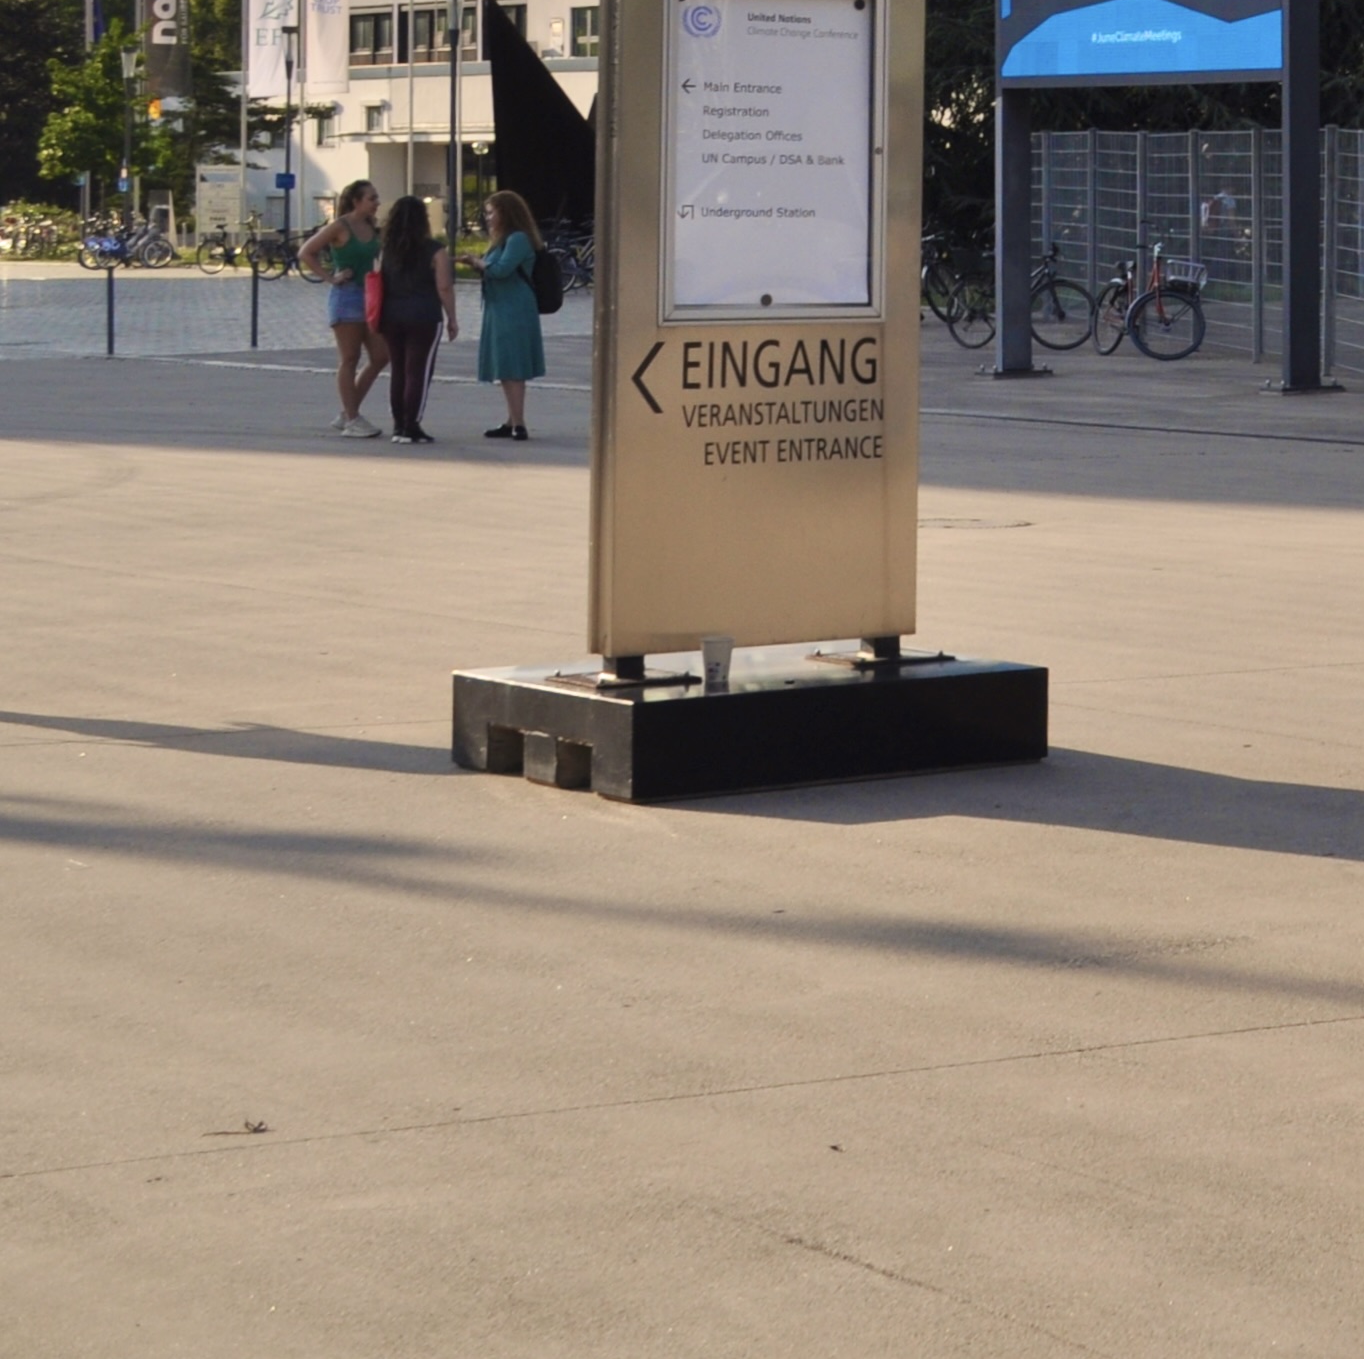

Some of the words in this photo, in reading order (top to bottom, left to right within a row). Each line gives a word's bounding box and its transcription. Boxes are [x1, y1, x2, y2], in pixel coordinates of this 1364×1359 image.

[311, 3, 342, 15] TRUST
[747, 13, 776, 23] United
[778, 14, 811, 24] Nations
[747, 26, 778, 36] Climate
[780, 27, 811, 39] Change
[813, 29, 859, 40] Conference
[704, 82, 729, 93] Main
[734, 82, 782, 94] Entrance
[703, 106, 769, 118] Registration
[703, 129, 761, 141] Delegation
[765, 130, 802, 141] Offices
[702, 154, 718, 164] UN
[722, 154, 766, 166] Campus
[779, 154, 802, 165] DSA
[806, 155, 814, 165] &
[817, 155, 844, 165] Bank
[701, 207, 773, 219] Underground
[776, 208, 815, 218] Station
[682, 337, 877, 390] EINGANG
[682, 398, 884, 428] VERANSTALTUNGEN
[704, 440, 770, 465] EVENT
[777, 436, 883, 462] ENTRANCE
